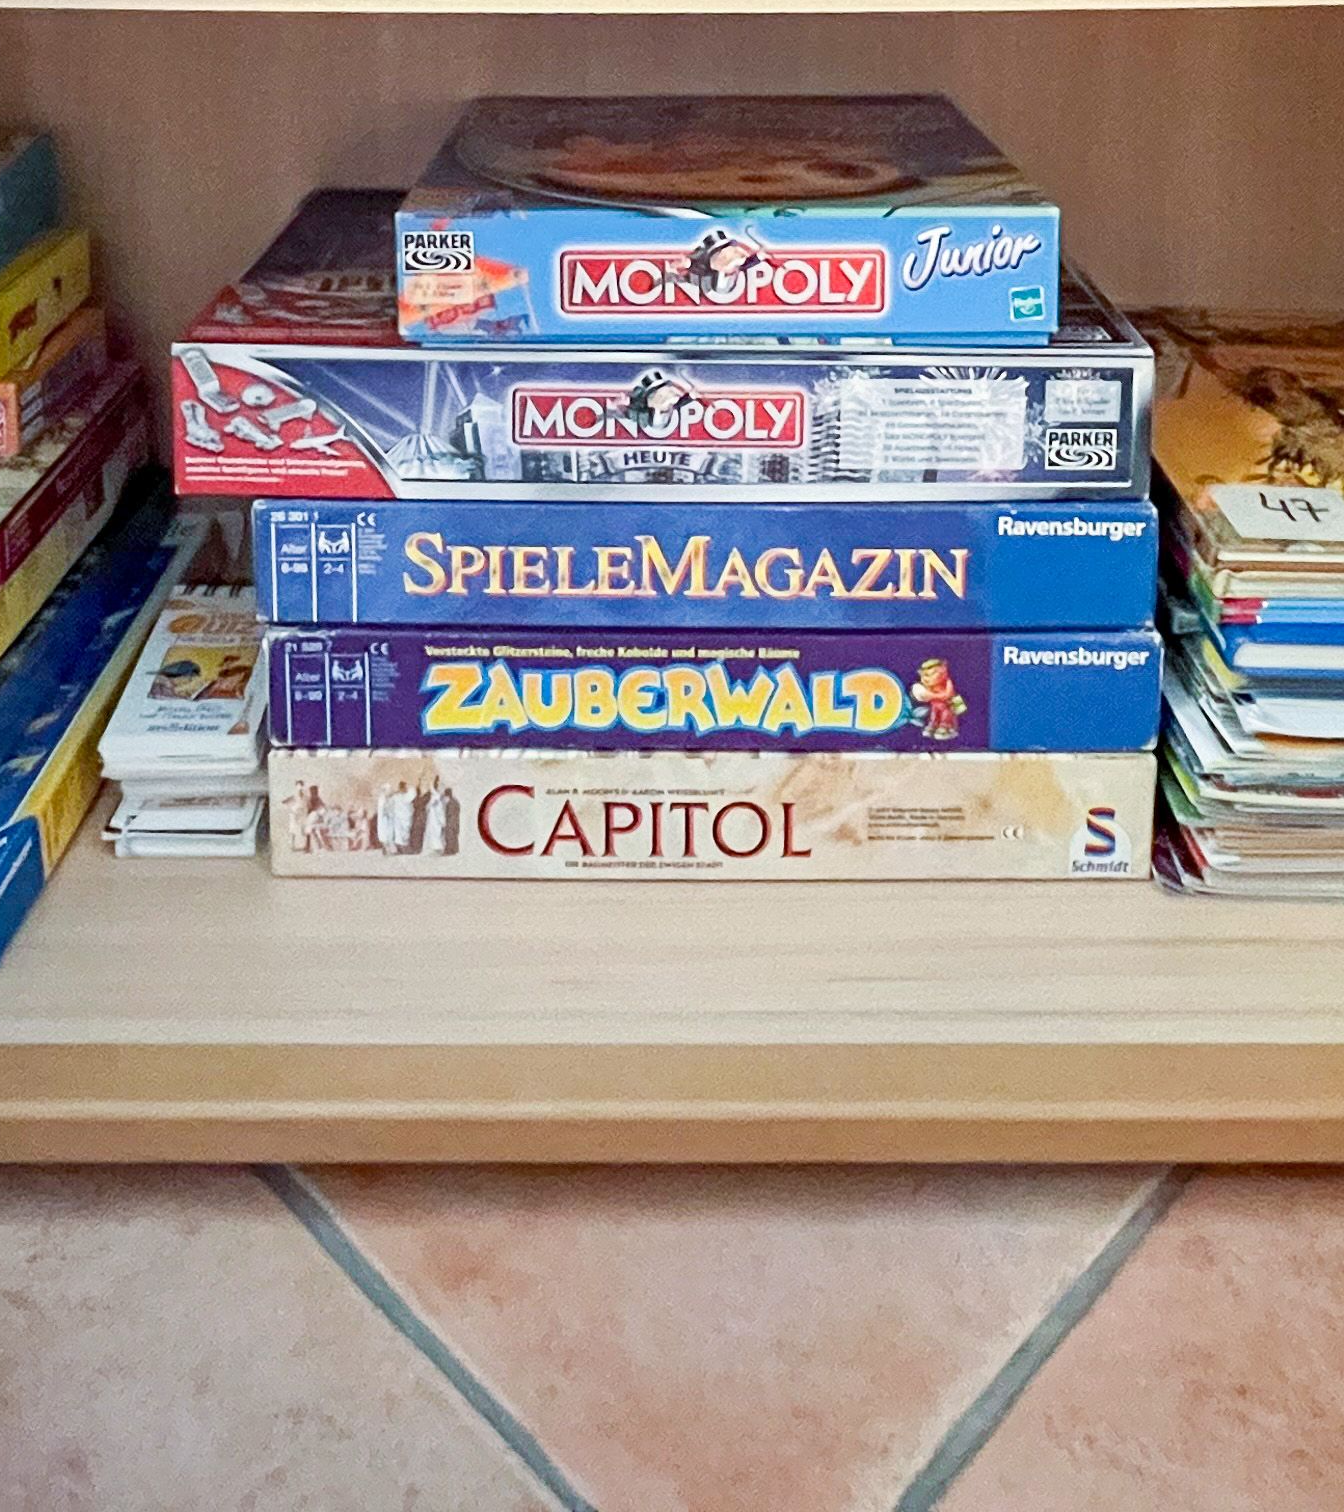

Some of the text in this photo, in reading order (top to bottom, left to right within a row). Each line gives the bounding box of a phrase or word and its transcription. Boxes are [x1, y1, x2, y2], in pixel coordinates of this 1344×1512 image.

[404, 233, 472, 249] PARKER
[902, 222, 1042, 290] Junior
[1048, 431, 1114, 447] PARKER
[623, 450, 693, 469] HEUTE
[1258, 490, 1331, 524] 47
[997, 515, 1147, 542] Ravensburger
[671, 646, 696, 658] und
[1002, 645, 1150, 672] Ravensburger
[424, 661, 905, 735] ZAUBERWALD
[476, 783, 812, 858] CAPITOL
[1071, 859, 1130, 874] Schmidt
